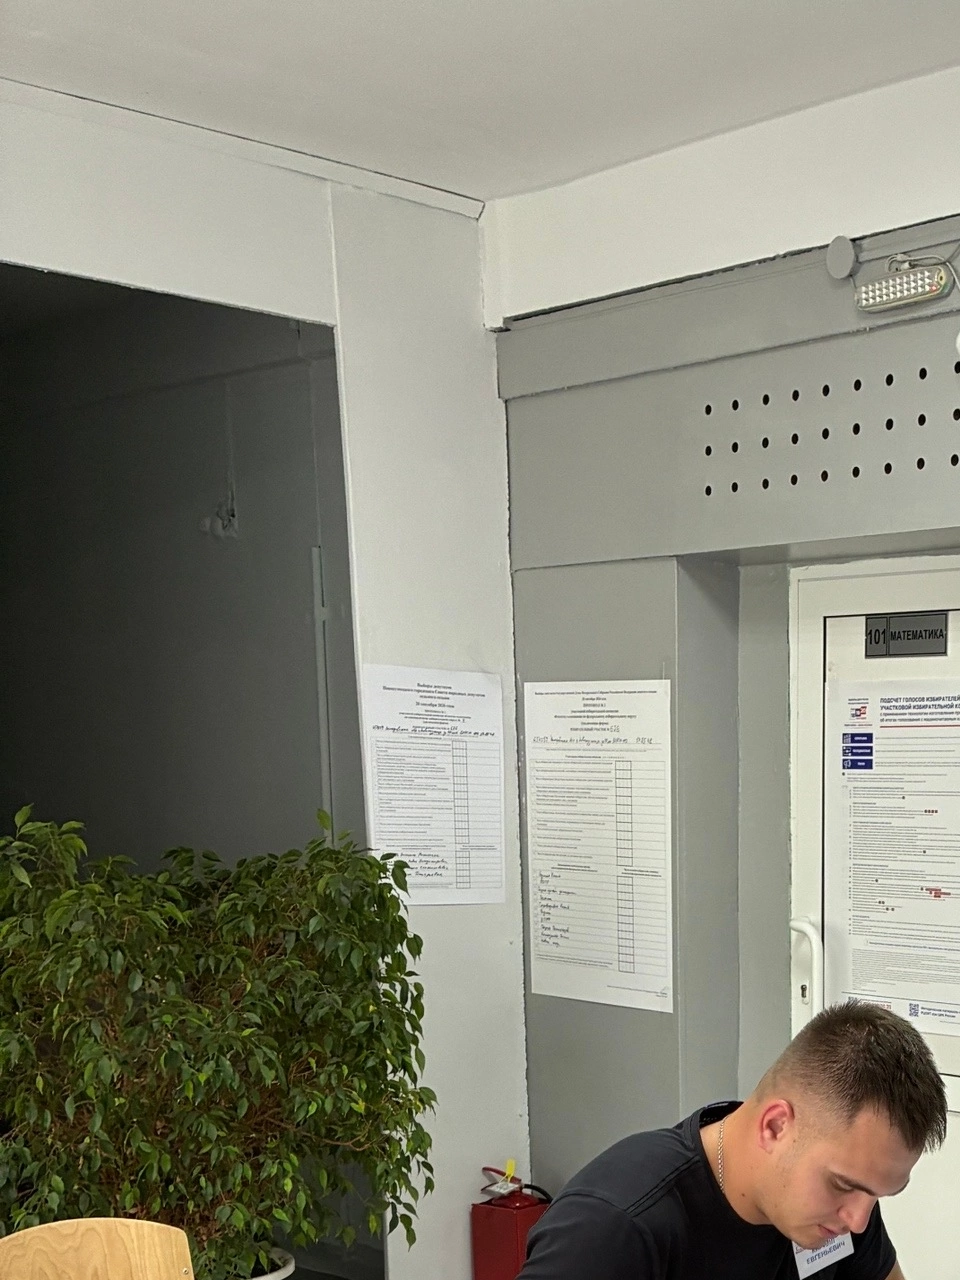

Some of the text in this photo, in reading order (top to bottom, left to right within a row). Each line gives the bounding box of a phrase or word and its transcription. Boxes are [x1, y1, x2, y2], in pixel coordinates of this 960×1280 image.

[867, 628, 886, 645] 101
[890, 628, 944, 642] МАТЕМАТИКА
[806, 1241, 845, 1264] ЕВГЕНЬЕВИЧ
